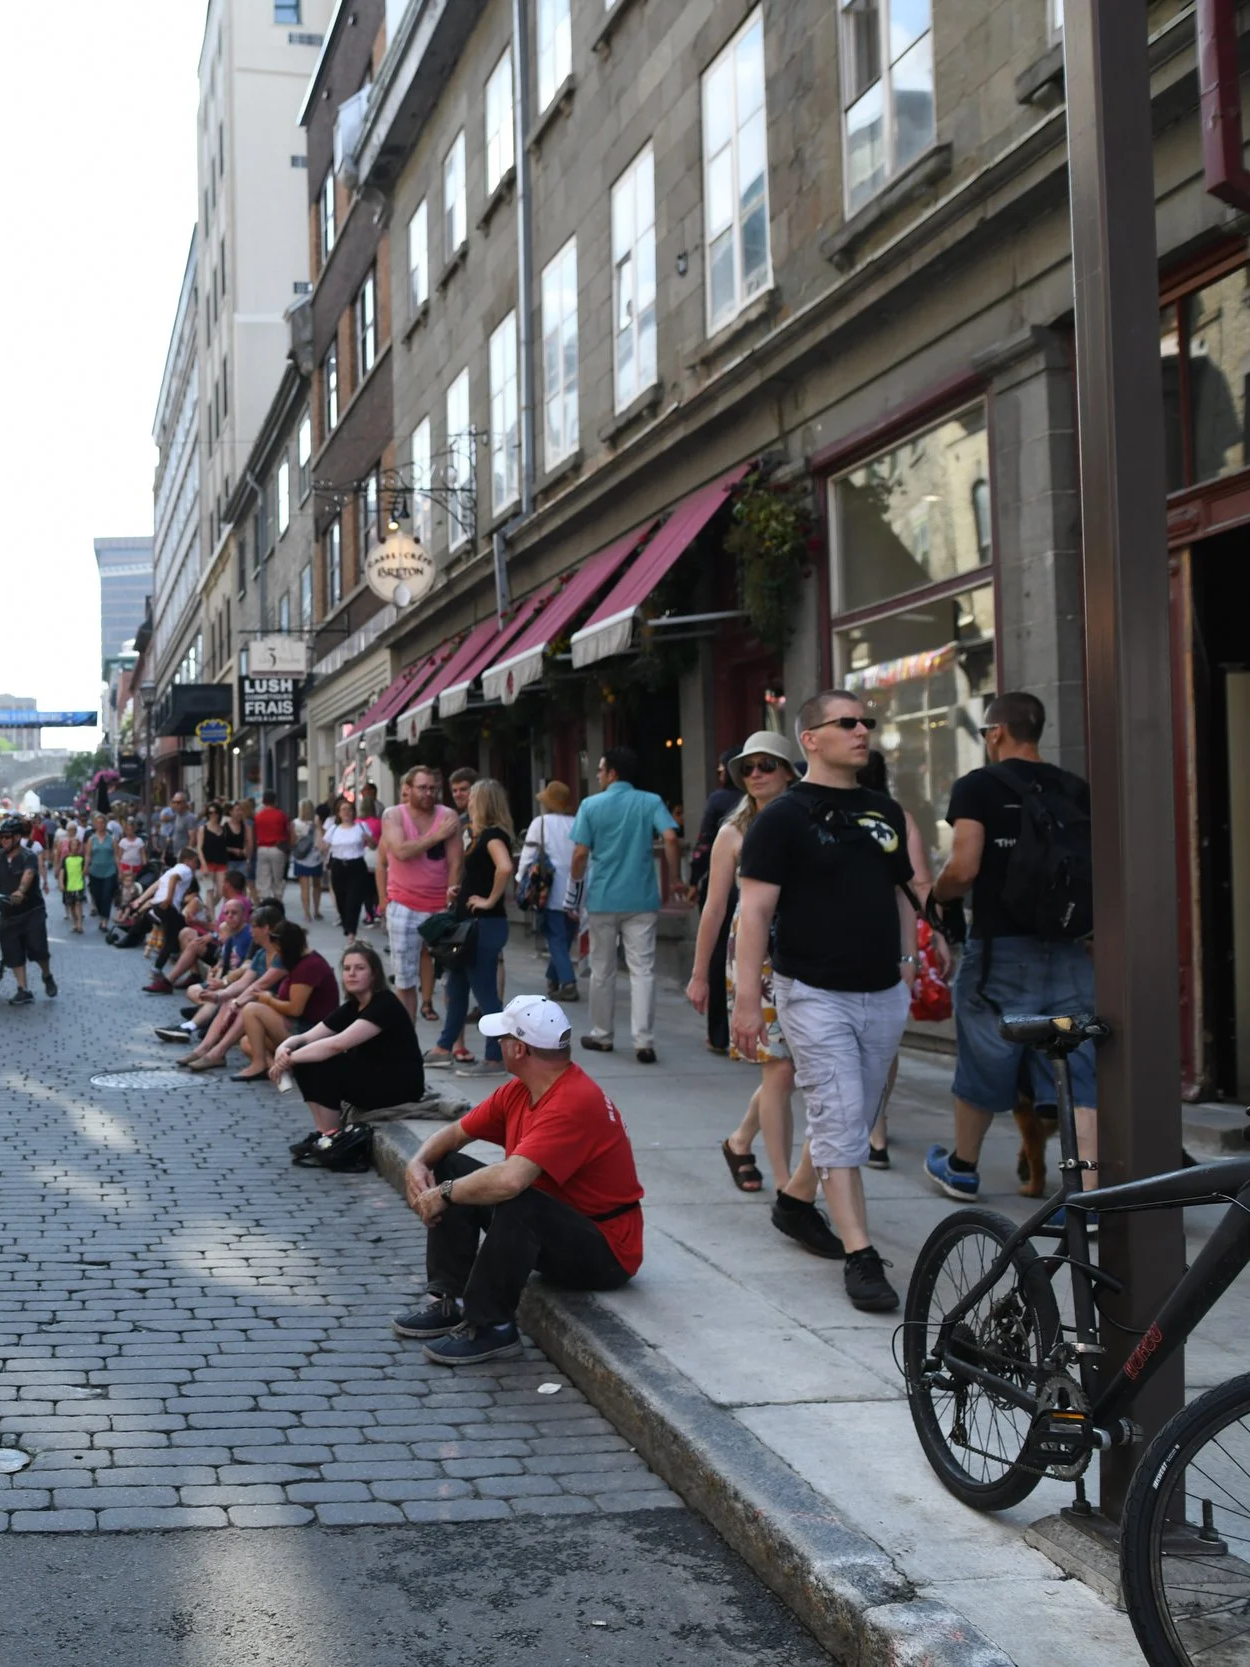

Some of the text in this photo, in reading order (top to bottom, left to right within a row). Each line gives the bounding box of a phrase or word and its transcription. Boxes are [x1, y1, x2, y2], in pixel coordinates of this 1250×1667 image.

[378, 566, 424, 579] BRETON
[244, 679, 293, 693] LUSH
[244, 700, 294, 715] FRAIS
